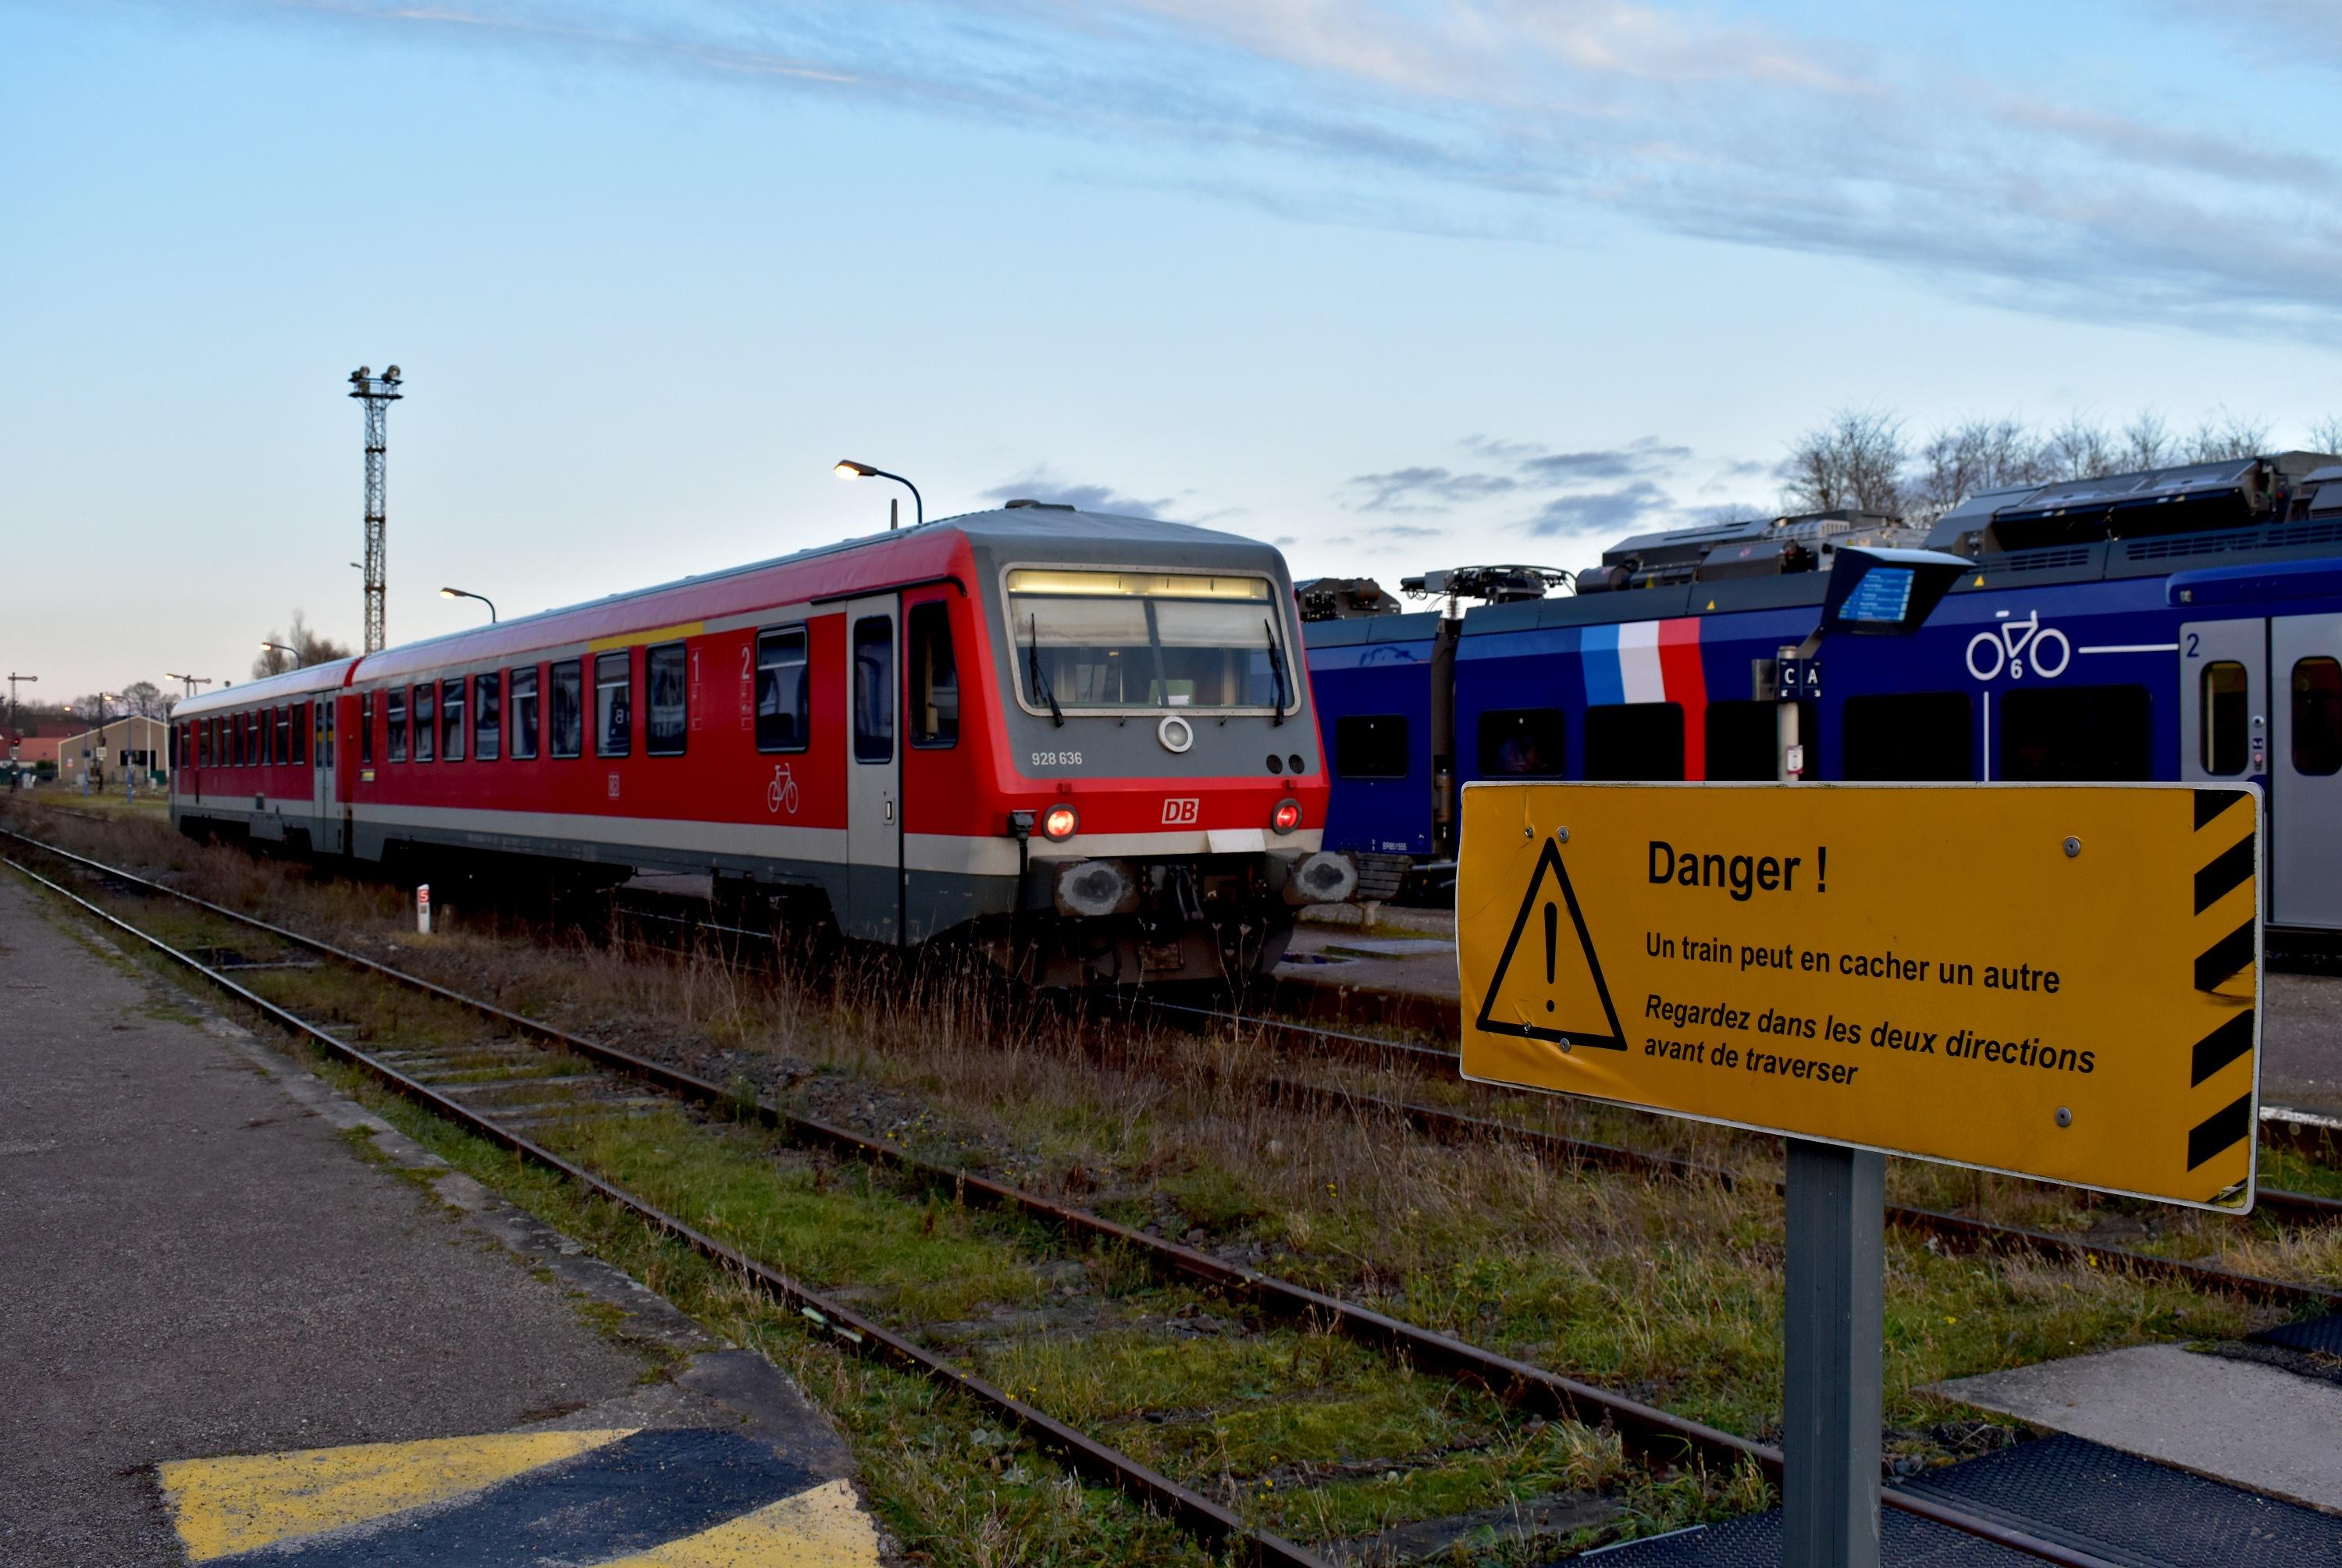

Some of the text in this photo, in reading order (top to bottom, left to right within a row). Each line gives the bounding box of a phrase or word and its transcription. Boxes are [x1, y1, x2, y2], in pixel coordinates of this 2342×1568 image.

[2187, 633, 2199, 657] 2
[693, 652, 699, 682] 1
[742, 647, 750, 680] 2
[1784, 667, 1796, 684] C
[1806, 667, 1818, 684] A
[2010, 659, 2023, 679] 6
[1031, 752, 1082, 766] 928 636
[1164, 801, 1196, 821] DB
[1649, 841, 1827, 902] Danger !
[1646, 931, 2060, 994] Un train peut en cacher un autre
[1645, 994, 2095, 1074] Regardez dans les deux directions
[1644, 1038, 1859, 1085] avant de traverser
